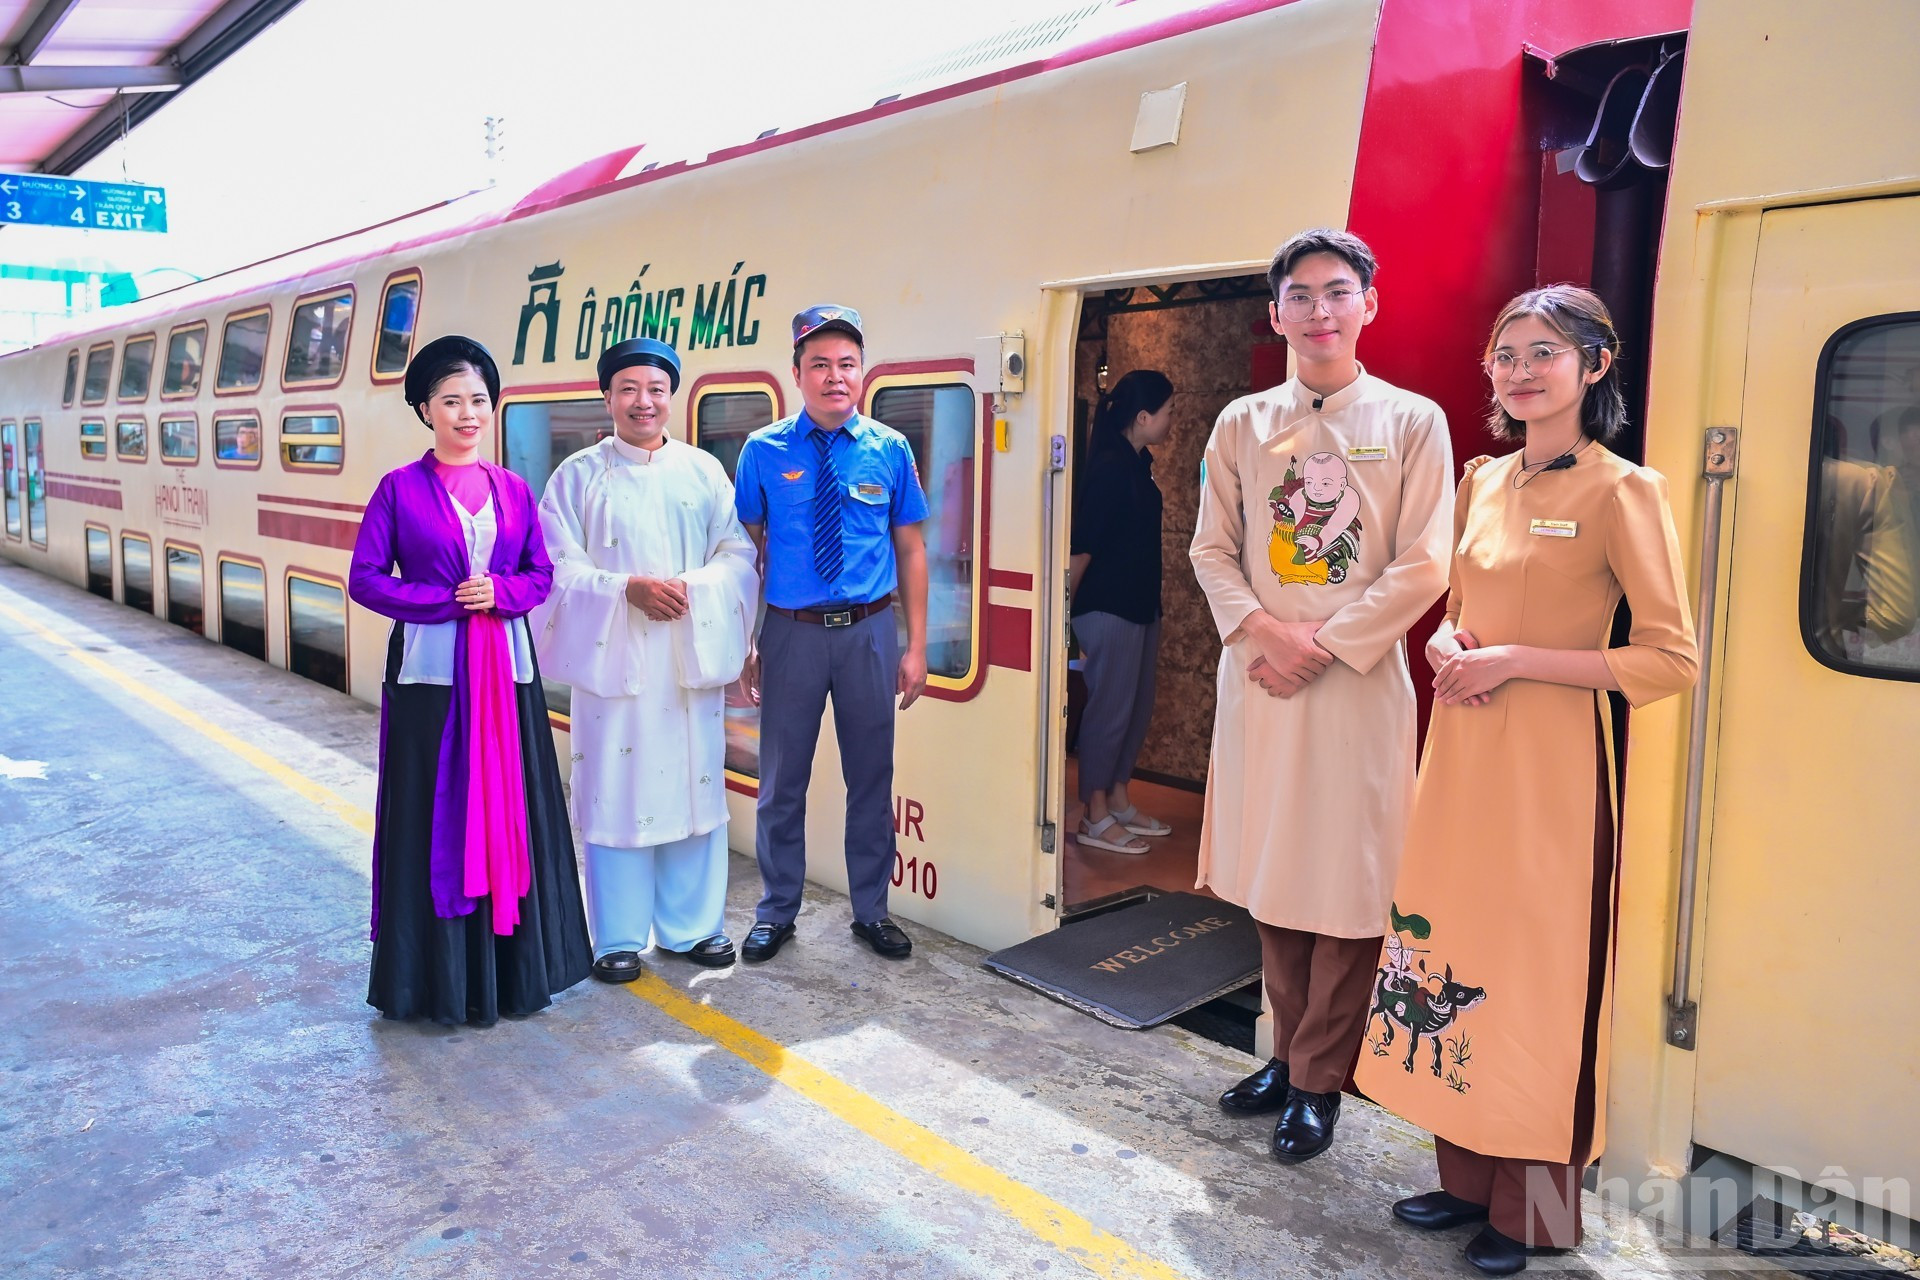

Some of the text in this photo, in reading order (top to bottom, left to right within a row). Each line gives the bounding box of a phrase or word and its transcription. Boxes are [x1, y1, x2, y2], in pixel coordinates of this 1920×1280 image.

[6, 201, 22, 220] 3
[70, 206, 86, 224] 4
[96, 211, 145, 229] EXIT
[575, 260, 767, 361] Ô ĐỐNG MÁC
[1089, 917, 1232, 973] WELCOME
